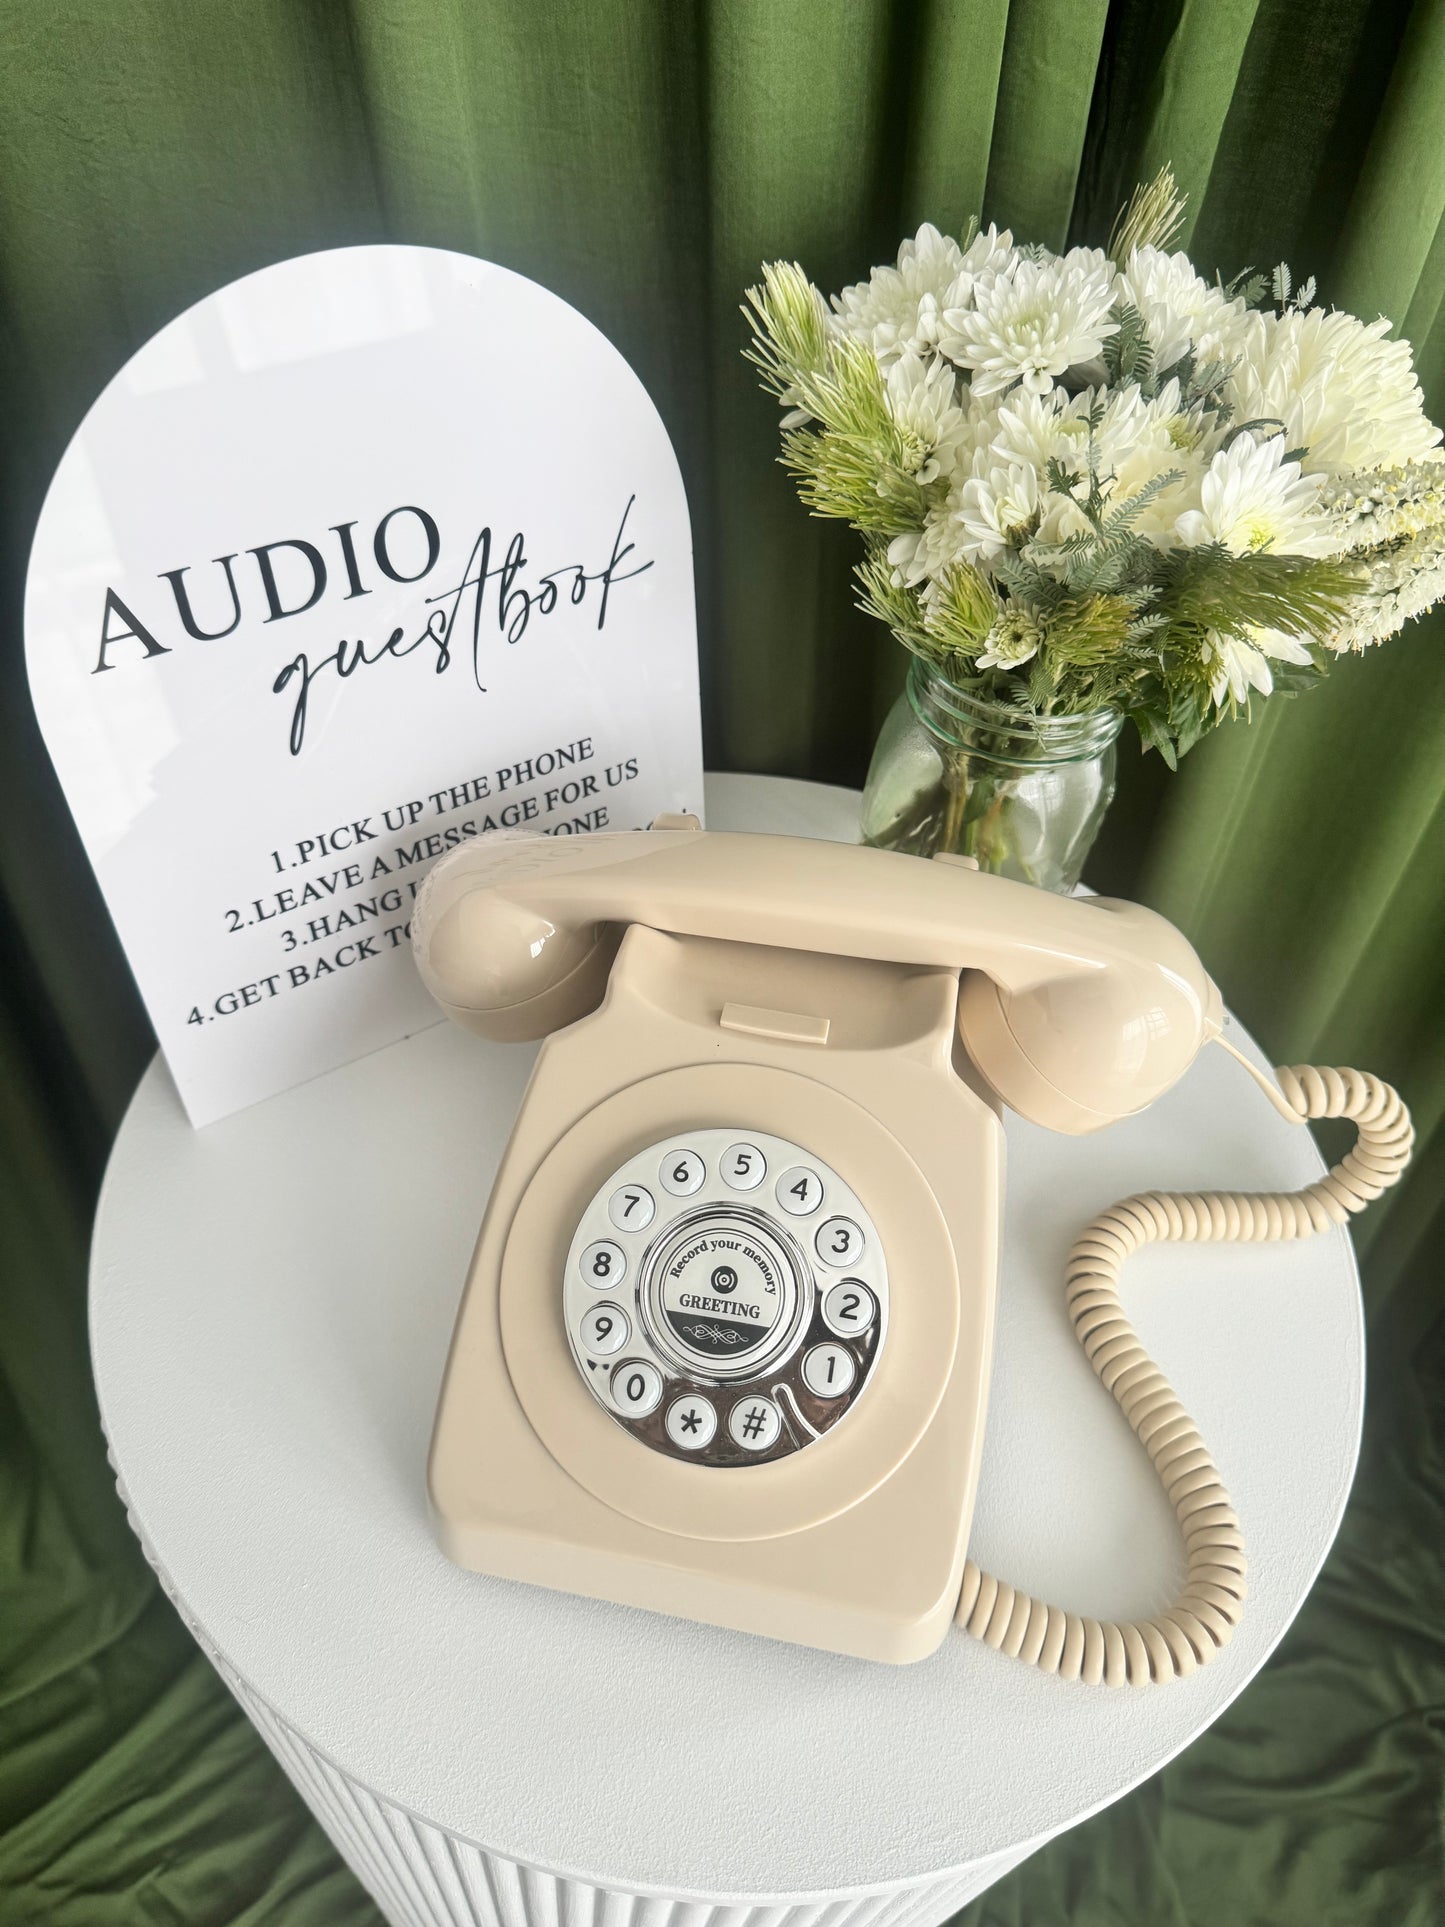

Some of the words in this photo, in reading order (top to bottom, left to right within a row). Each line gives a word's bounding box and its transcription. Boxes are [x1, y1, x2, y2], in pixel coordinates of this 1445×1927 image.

[91, 505, 441, 675] AUDIO
[273, 494, 655, 756] guestbook
[270, 817, 378, 873] 1.PICK
[382, 800, 425, 833] UP
[428, 776, 492, 815] THE
[496, 737, 596, 792] PHONE
[224, 863, 365, 933] 2.LEAVE
[369, 856, 393, 880] A
[395, 797, 540, 870] MESSAGE
[544, 776, 601, 812] FOR
[604, 758, 640, 789] US
[280, 889, 403, 952] 3.HANG
[186, 974, 283, 1027] 4.GET
[287, 937, 383, 989] BACK
[672, 1160, 690, 1183] 6
[734, 1153, 752, 1176] 5
[790, 1178, 809, 1202] 4
[623, 1194, 641, 1218] 7
[831, 1229, 850, 1254] 3
[592, 1251, 612, 1277] 8
[670, 1240, 709, 1278] Record
[710, 1239, 742, 1252] your
[742, 1246, 776, 1296] memory
[679, 1293, 761, 1319] GREETING
[839, 1293, 862, 1321] 2
[594, 1316, 613, 1343] 9
[826, 1355, 837, 1384] 1
[626, 1372, 646, 1402] 0
[742, 1406, 767, 1440] #
